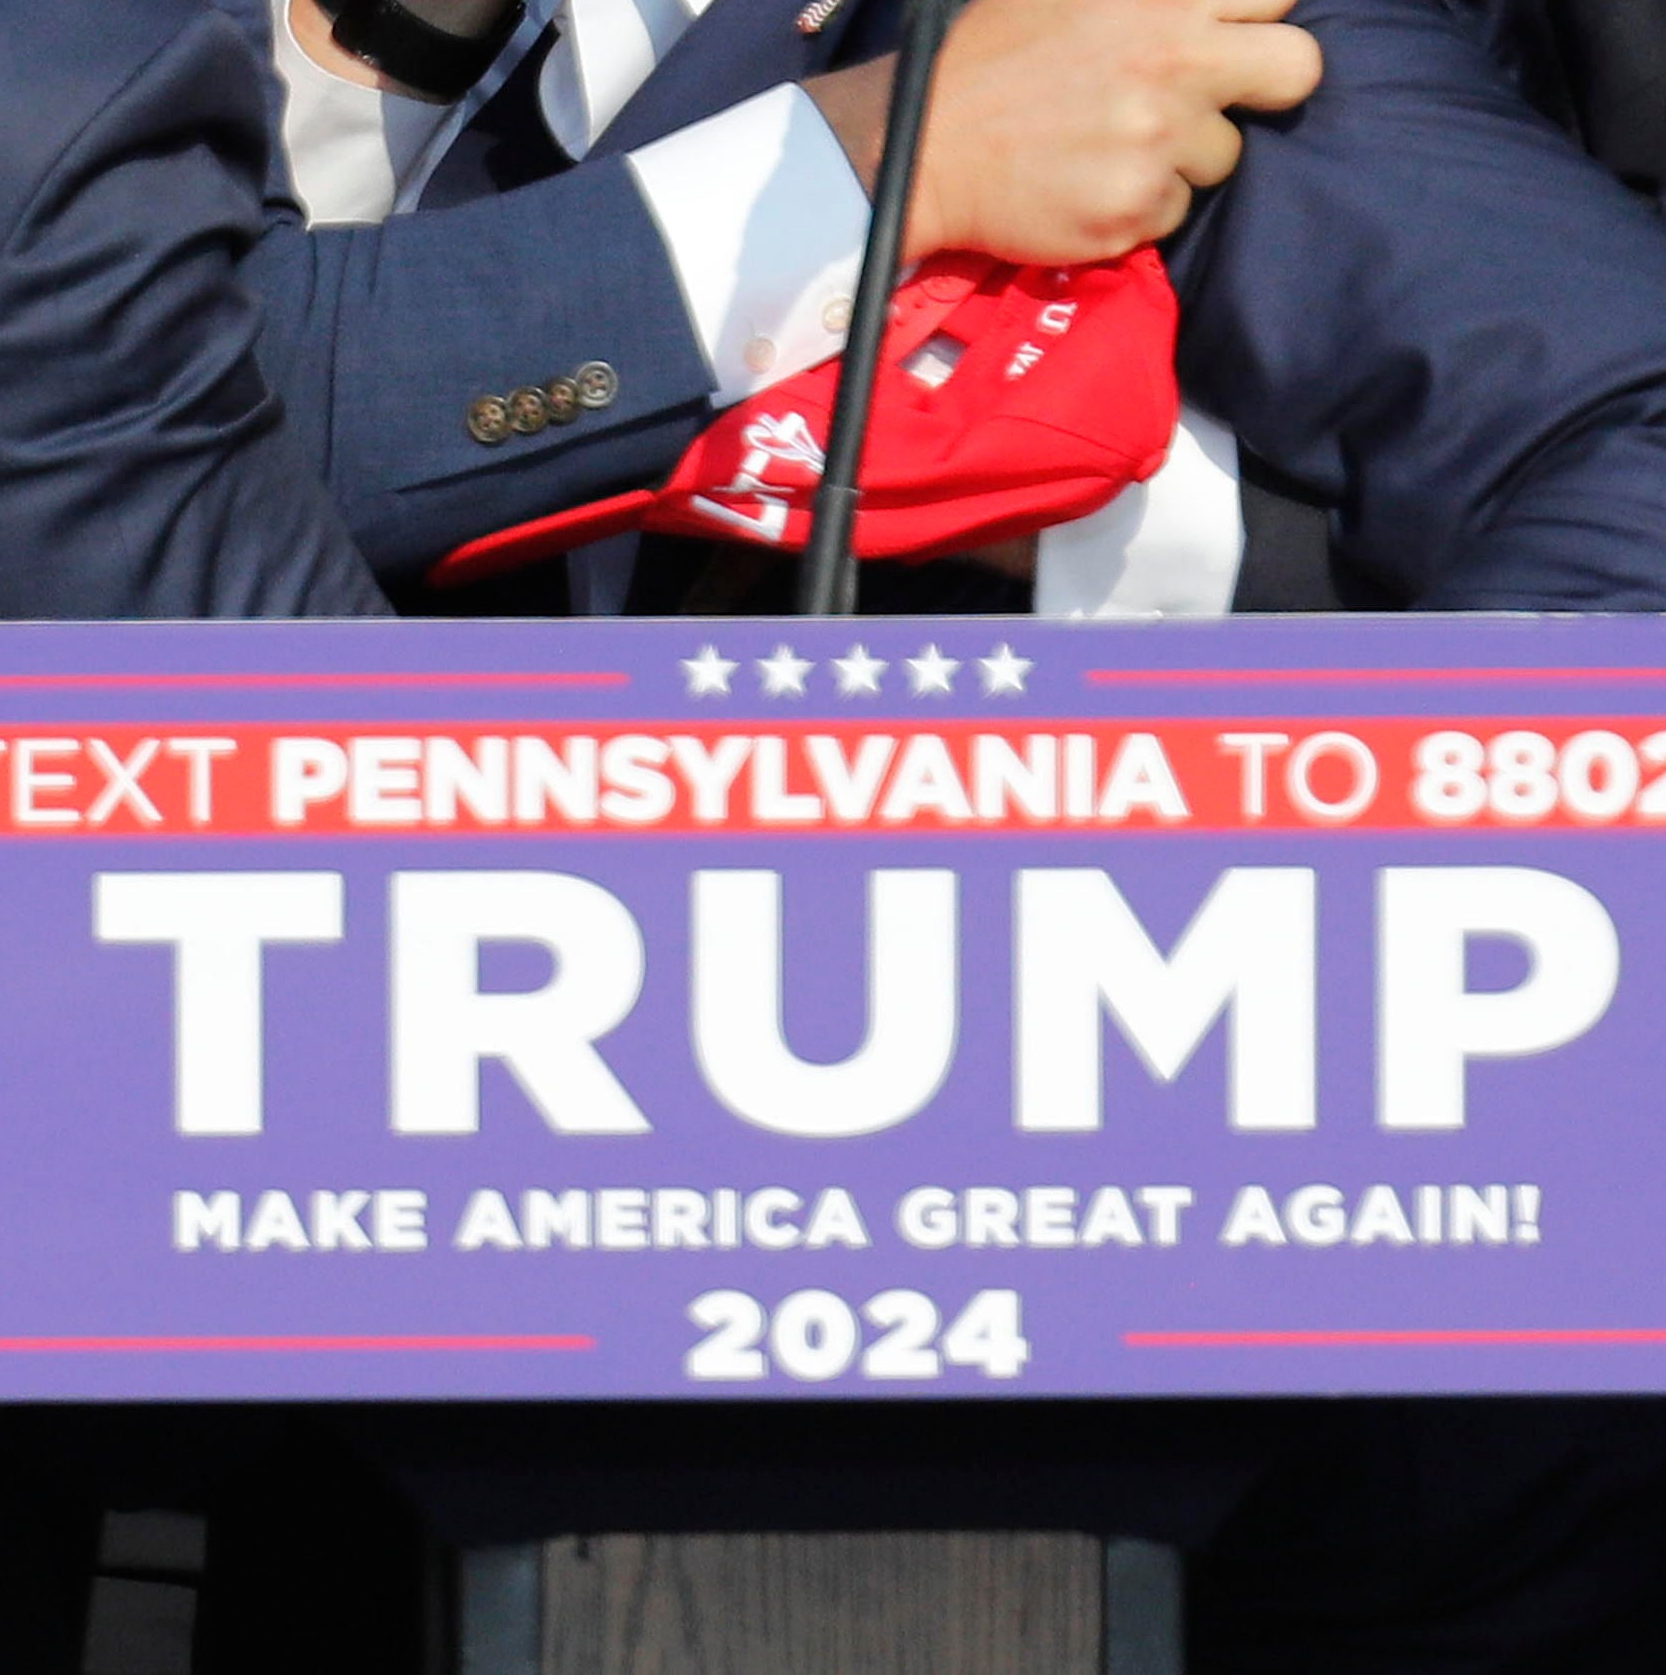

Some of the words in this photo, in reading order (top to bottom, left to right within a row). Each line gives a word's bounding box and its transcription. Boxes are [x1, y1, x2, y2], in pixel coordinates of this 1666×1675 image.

[271, 733, 1190, 823] PENNSYLVANIA
[1218, 731, 1378, 818] TO
[94, 866, 1620, 1138] TRUMP
[174, 1190, 427, 1251] MAKE
[456, 1187, 868, 1250] AMERICA
[898, 1186, 1193, 1249] GREAT
[1222, 1184, 1540, 1246] AGAIN!
[687, 1289, 1028, 1381] 2024
